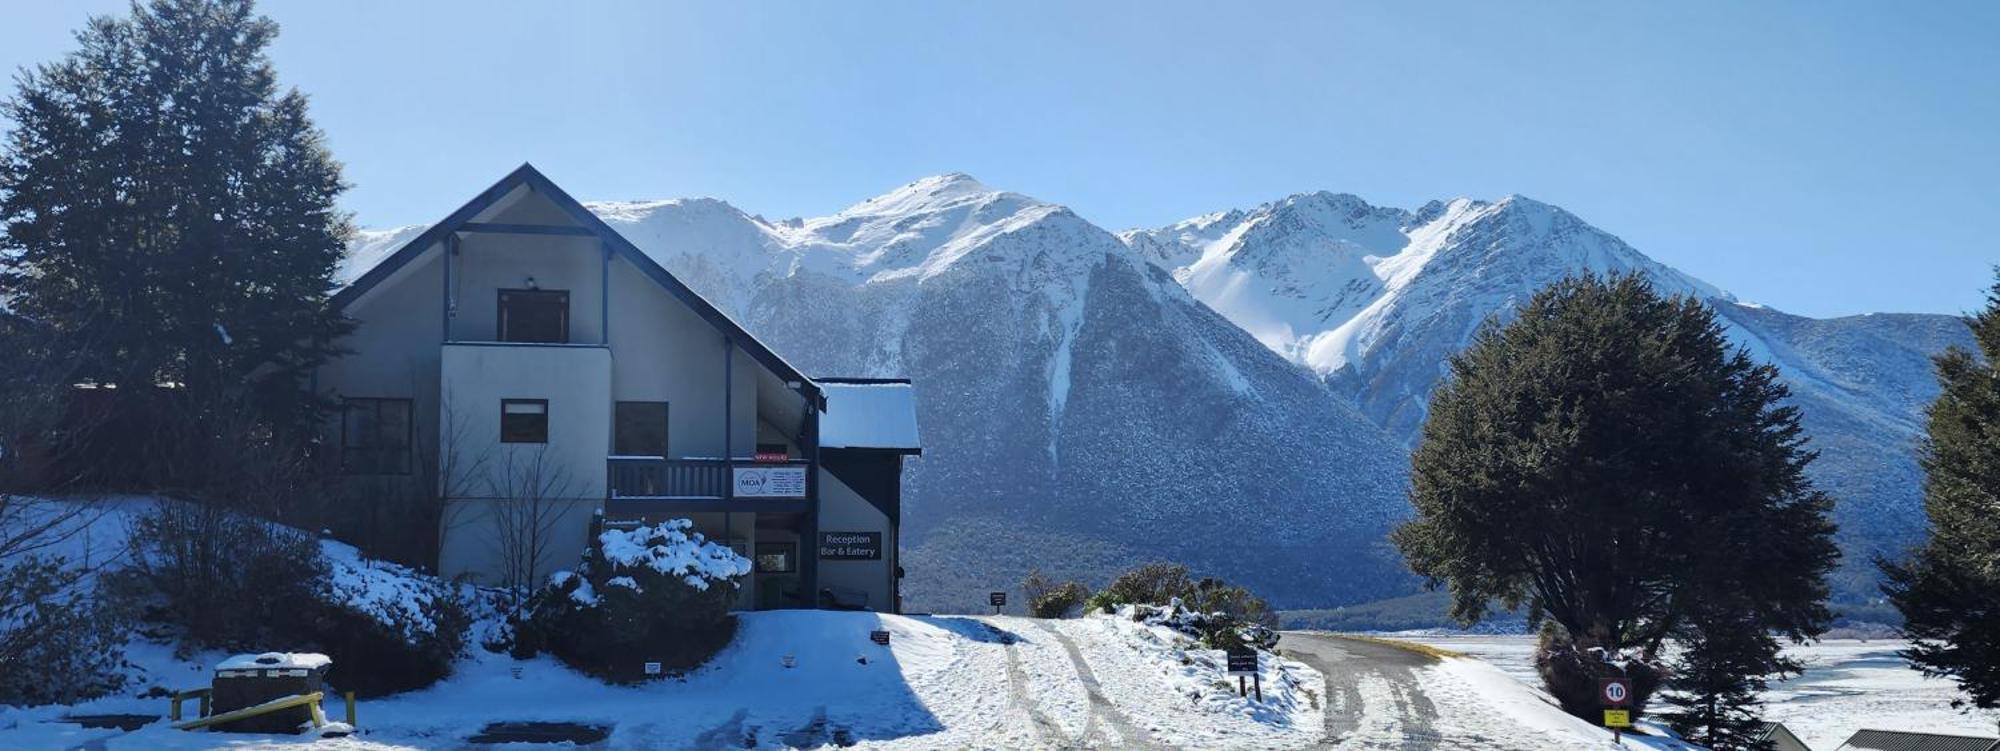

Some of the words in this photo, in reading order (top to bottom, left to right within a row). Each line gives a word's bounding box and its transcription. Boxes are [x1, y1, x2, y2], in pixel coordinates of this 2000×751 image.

[741, 479, 760, 487] MOA
[826, 534, 870, 545] Reception
[821, 547, 836, 556] Bar
[838, 547, 845, 556] &
[846, 547, 875, 558] Eatery
[1608, 687, 1623, 697] 10
